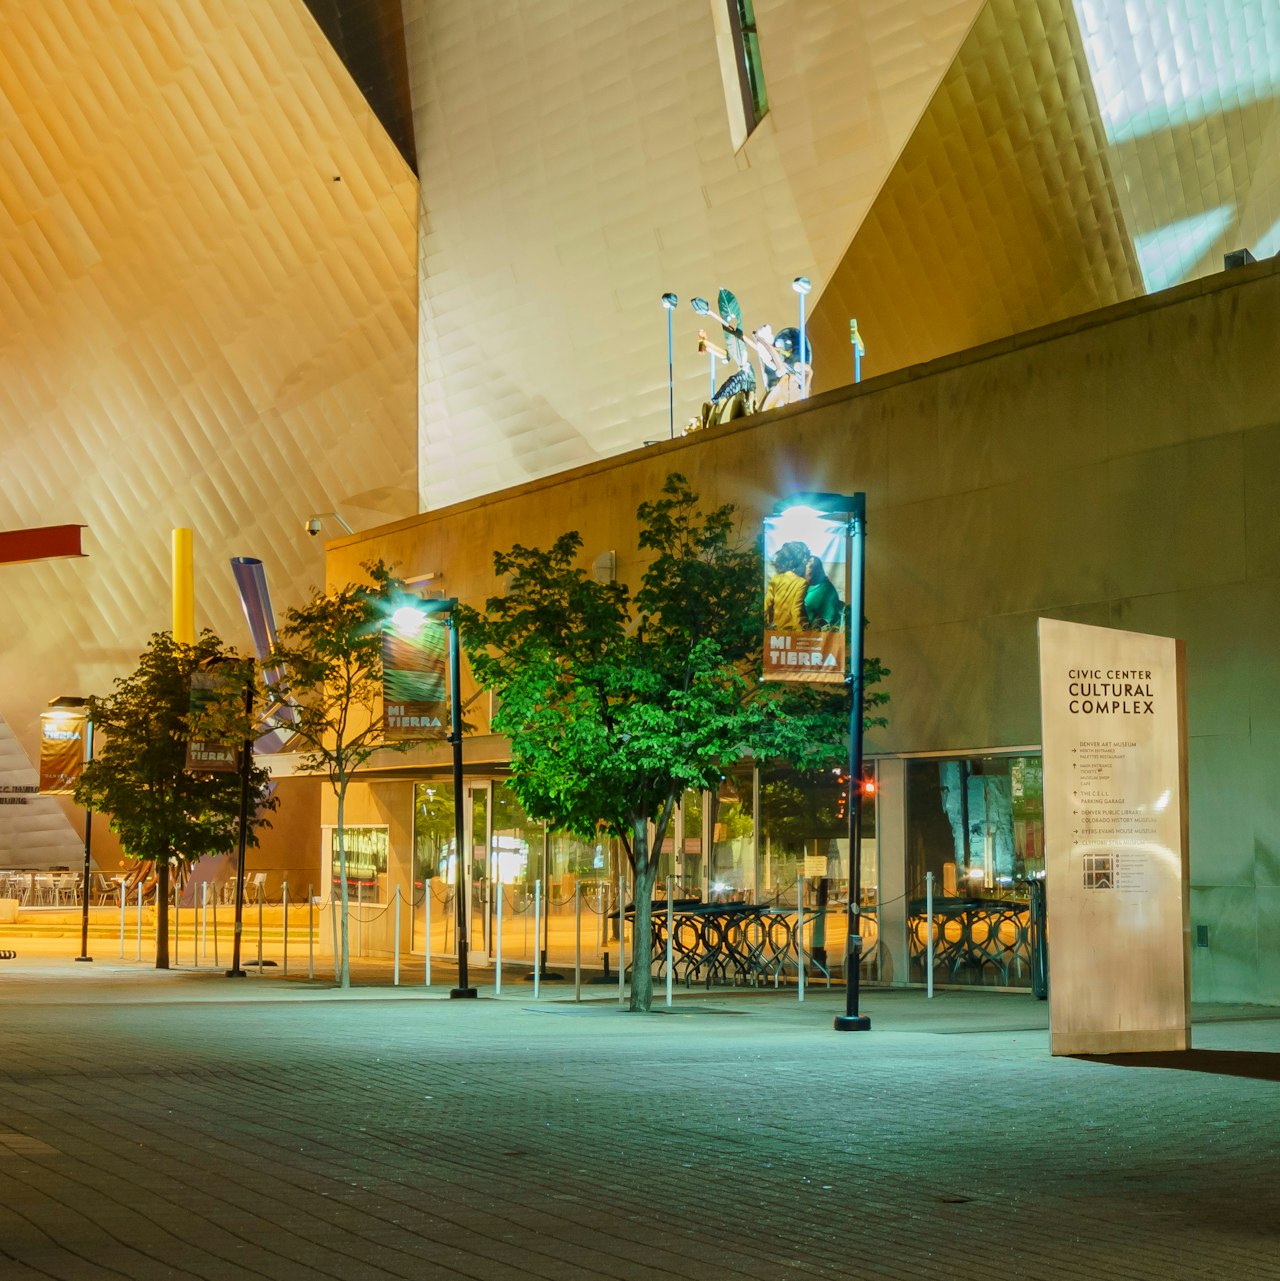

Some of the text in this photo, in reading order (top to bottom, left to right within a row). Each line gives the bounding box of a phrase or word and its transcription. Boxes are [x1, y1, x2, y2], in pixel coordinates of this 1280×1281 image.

[770, 635, 792, 650] MI
[769, 651, 838, 667] TIERRA
[1068, 669, 1152, 680] CIVIC CENTER
[1068, 682, 1154, 697] CULTURAL
[388, 705, 405, 716] MI
[1069, 700, 1155, 714] COMPLEX
[388, 716, 442, 728] TIERRA
[190, 751, 234, 762] TIERRA
